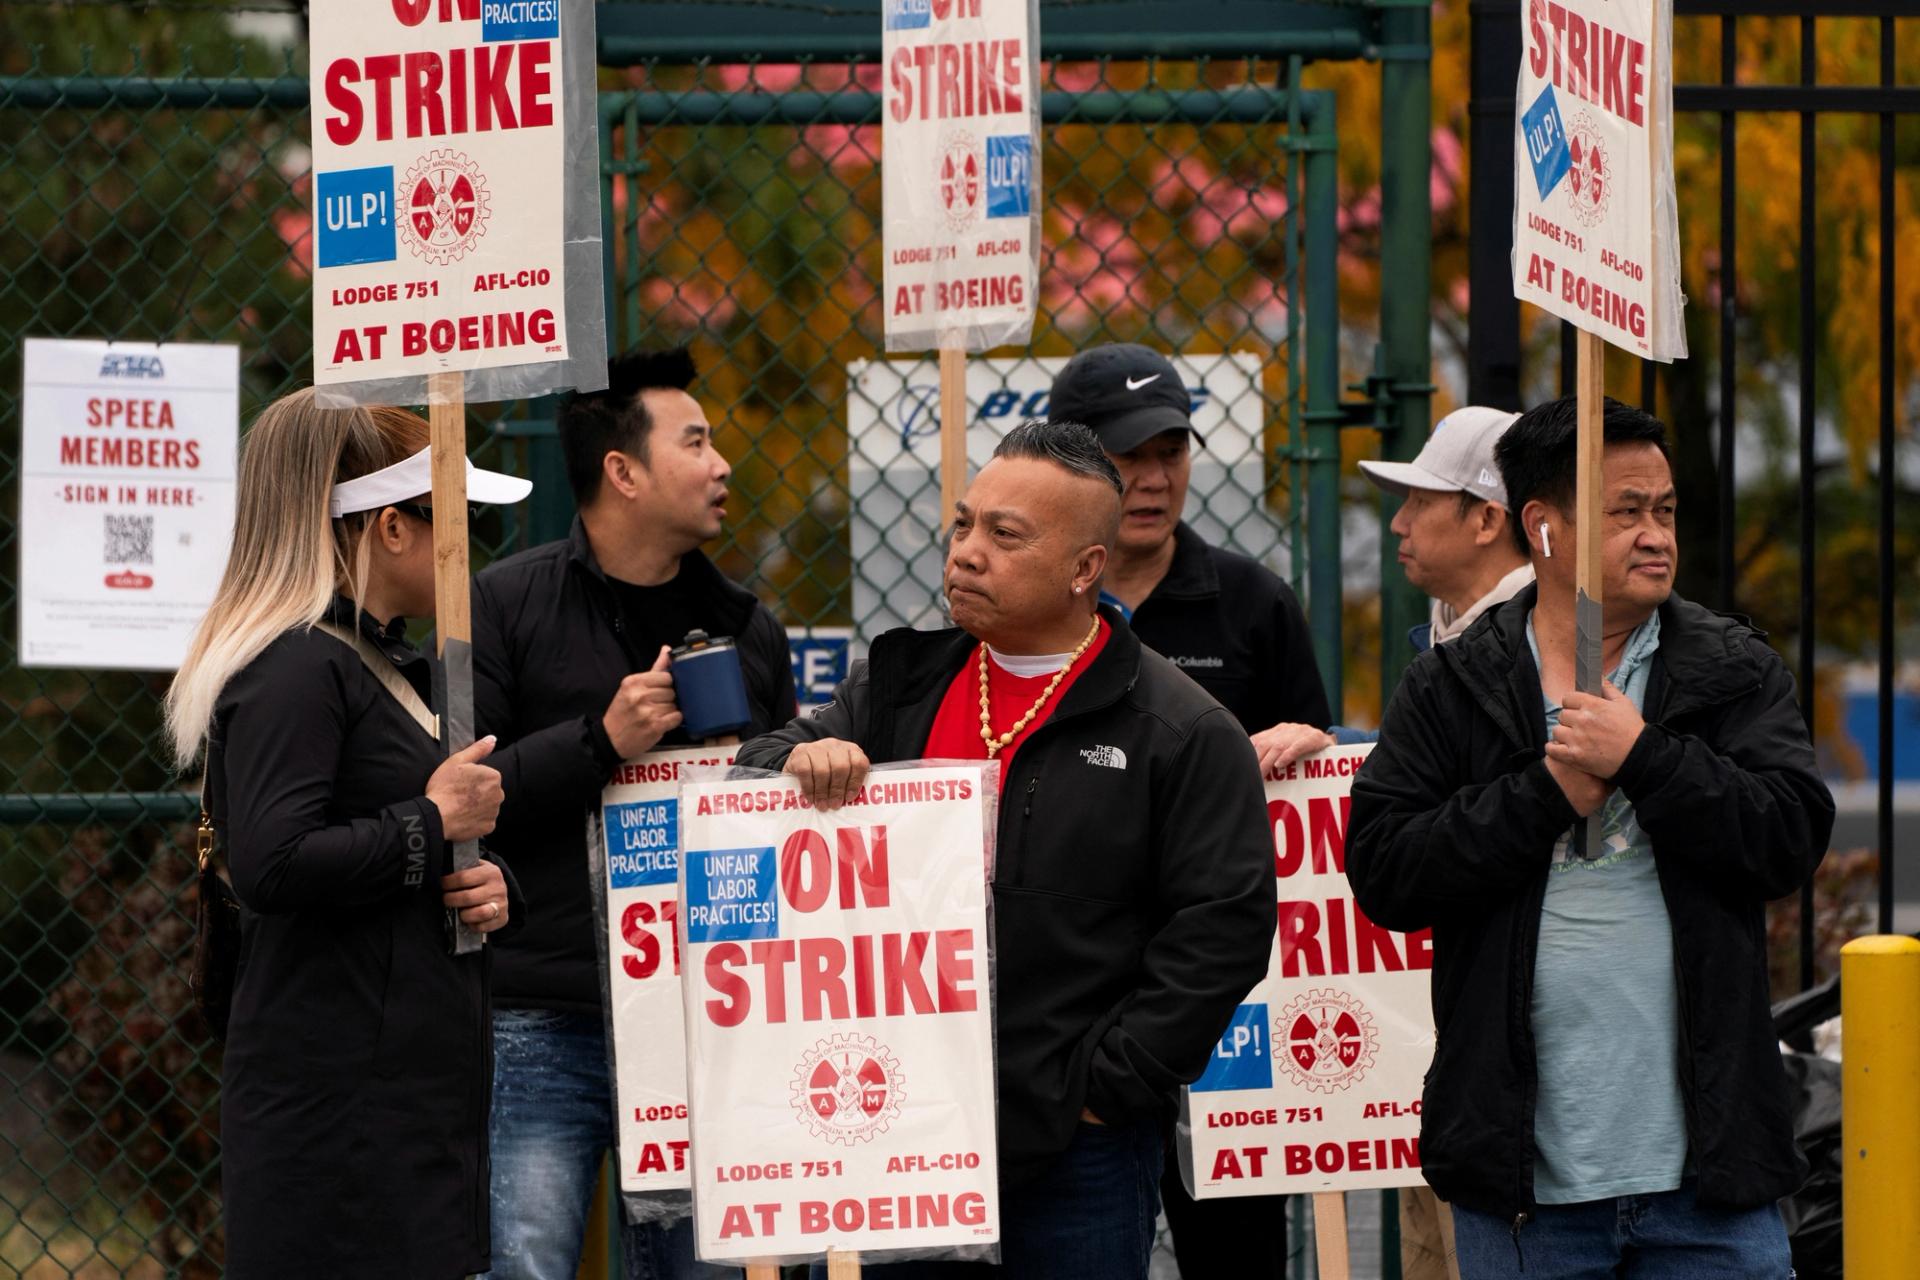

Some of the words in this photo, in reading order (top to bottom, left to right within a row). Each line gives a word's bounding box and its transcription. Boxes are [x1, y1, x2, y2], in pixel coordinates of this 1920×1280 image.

[485, 1, 557, 24] PRACTICES!
[1530, 0, 1646, 128] STRIKE
[324, 41, 554, 147] STRIKE
[891, 40, 1024, 122] STRIKE
[1528, 107, 1562, 164] ULP!
[991, 154, 1027, 187] ULP!
[326, 191, 388, 231] ULP!
[419, 216, 429, 229] A
[458, 212, 469, 225] M
[893, 249, 932, 265] LODGE
[976, 239, 1021, 257] AFL-CIO
[1528, 210, 1561, 243] LODGE
[1563, 228, 1584, 255] 751
[1599, 246, 1645, 285] AFL-CIO
[332, 284, 399, 308] LODGE
[406, 280, 440, 301] 751
[472, 268, 552, 293] AFL-CIO
[894, 284, 925, 317] AT
[934, 272, 1024, 312] BOEING
[1526, 250, 1557, 295] AT
[1560, 265, 1647, 340] BOEING
[333, 325, 390, 365] AT
[402, 308, 556, 357] BOEING
[86, 397, 175, 430] SPEEA
[60, 436, 201, 470] MEMBERS
[62, 484, 110, 503] SIGN
[117, 486, 138, 504] IN
[145, 487, 195, 508] HERE
[1079, 749, 1112, 760] NORTH
[1087, 757, 1110, 767] FACE
[1095, 744, 1114, 754] THE
[620, 806, 668, 829] UNFAIR
[697, 788, 813, 816] AEROSPAC
[402, 814, 425, 888] EMON
[624, 828, 667, 851] LABOR
[1266, 796, 1352, 879] ON
[610, 849, 679, 876] PRACTICES
[704, 855, 760, 878] UNFAIR
[782, 826, 891, 913] ON
[707, 876, 758, 901] LABOR
[689, 902, 777, 928] PRACTICES!
[1277, 897, 1434, 979] RIKE
[705, 929, 979, 1029] STRIKE
[1213, 1025, 1263, 1059] LP!
[1299, 1048, 1309, 1060] A
[1343, 1046, 1354, 1058] M
[635, 1105, 689, 1124] LODG
[818, 1097, 829, 1110] A
[867, 1095, 879, 1107] M
[1208, 1108, 1278, 1130] LODGE
[1285, 1106, 1324, 1124] 751
[1363, 1098, 1424, 1119] AFL-C
[636, 1140, 690, 1175] AT
[717, 1163, 793, 1183] LODGE
[801, 1161, 843, 1179] 751
[888, 1153, 982, 1174] AFL-CIO
[1212, 1146, 1270, 1182] AT
[1284, 1137, 1422, 1178] BOEIN
[718, 1203, 782, 1239] AT
[799, 1192, 987, 1235] BOEING
